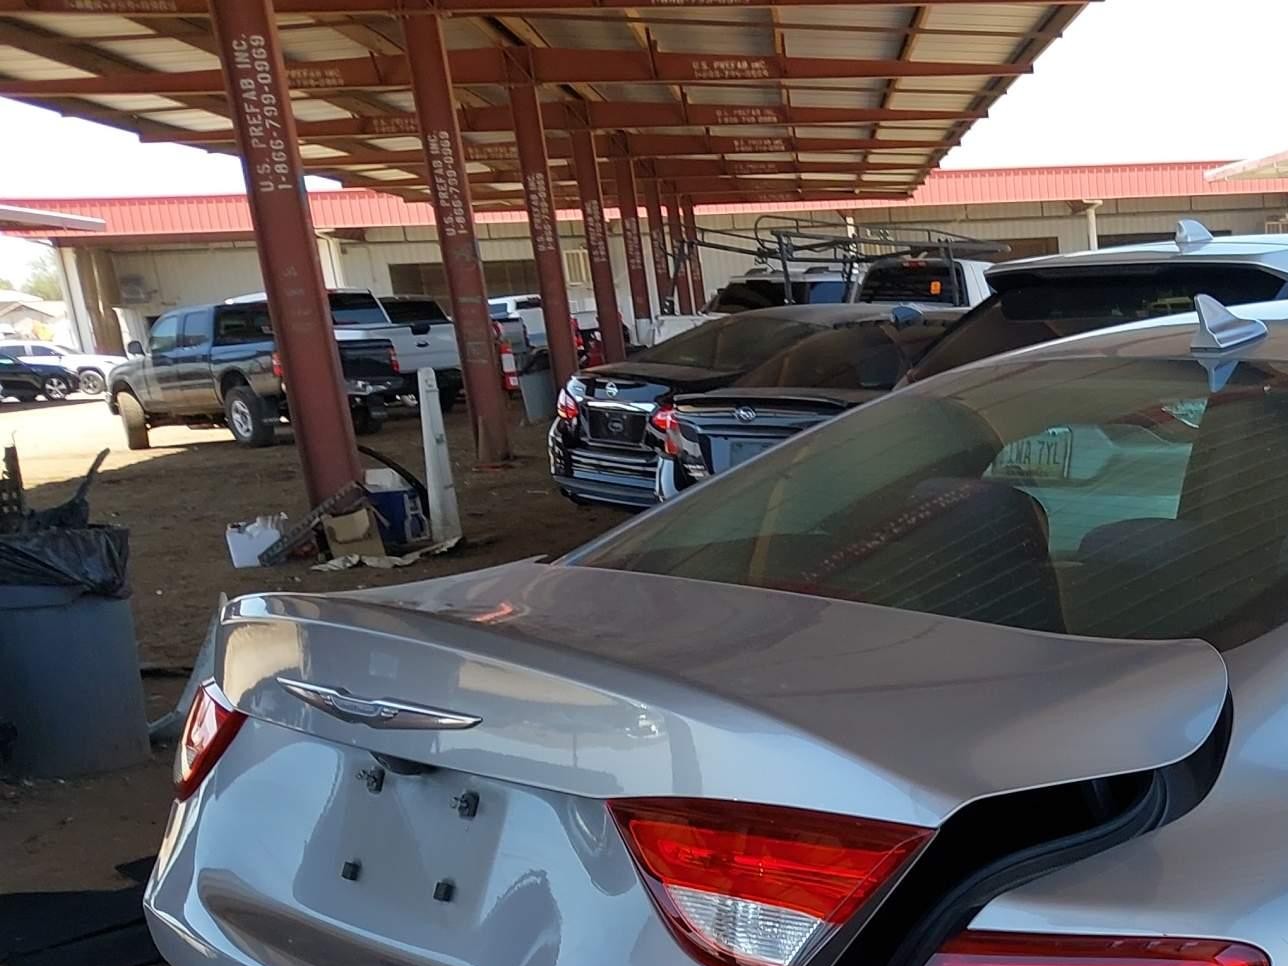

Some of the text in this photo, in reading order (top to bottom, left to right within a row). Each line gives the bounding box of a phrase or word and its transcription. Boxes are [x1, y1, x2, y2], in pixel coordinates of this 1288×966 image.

[240, 78, 267, 148] PREFAB
[250, 35, 292, 190] 1-866-799-0969
[256, 158, 274, 192] U.S.
[432, 159, 450, 207] PREFAB
